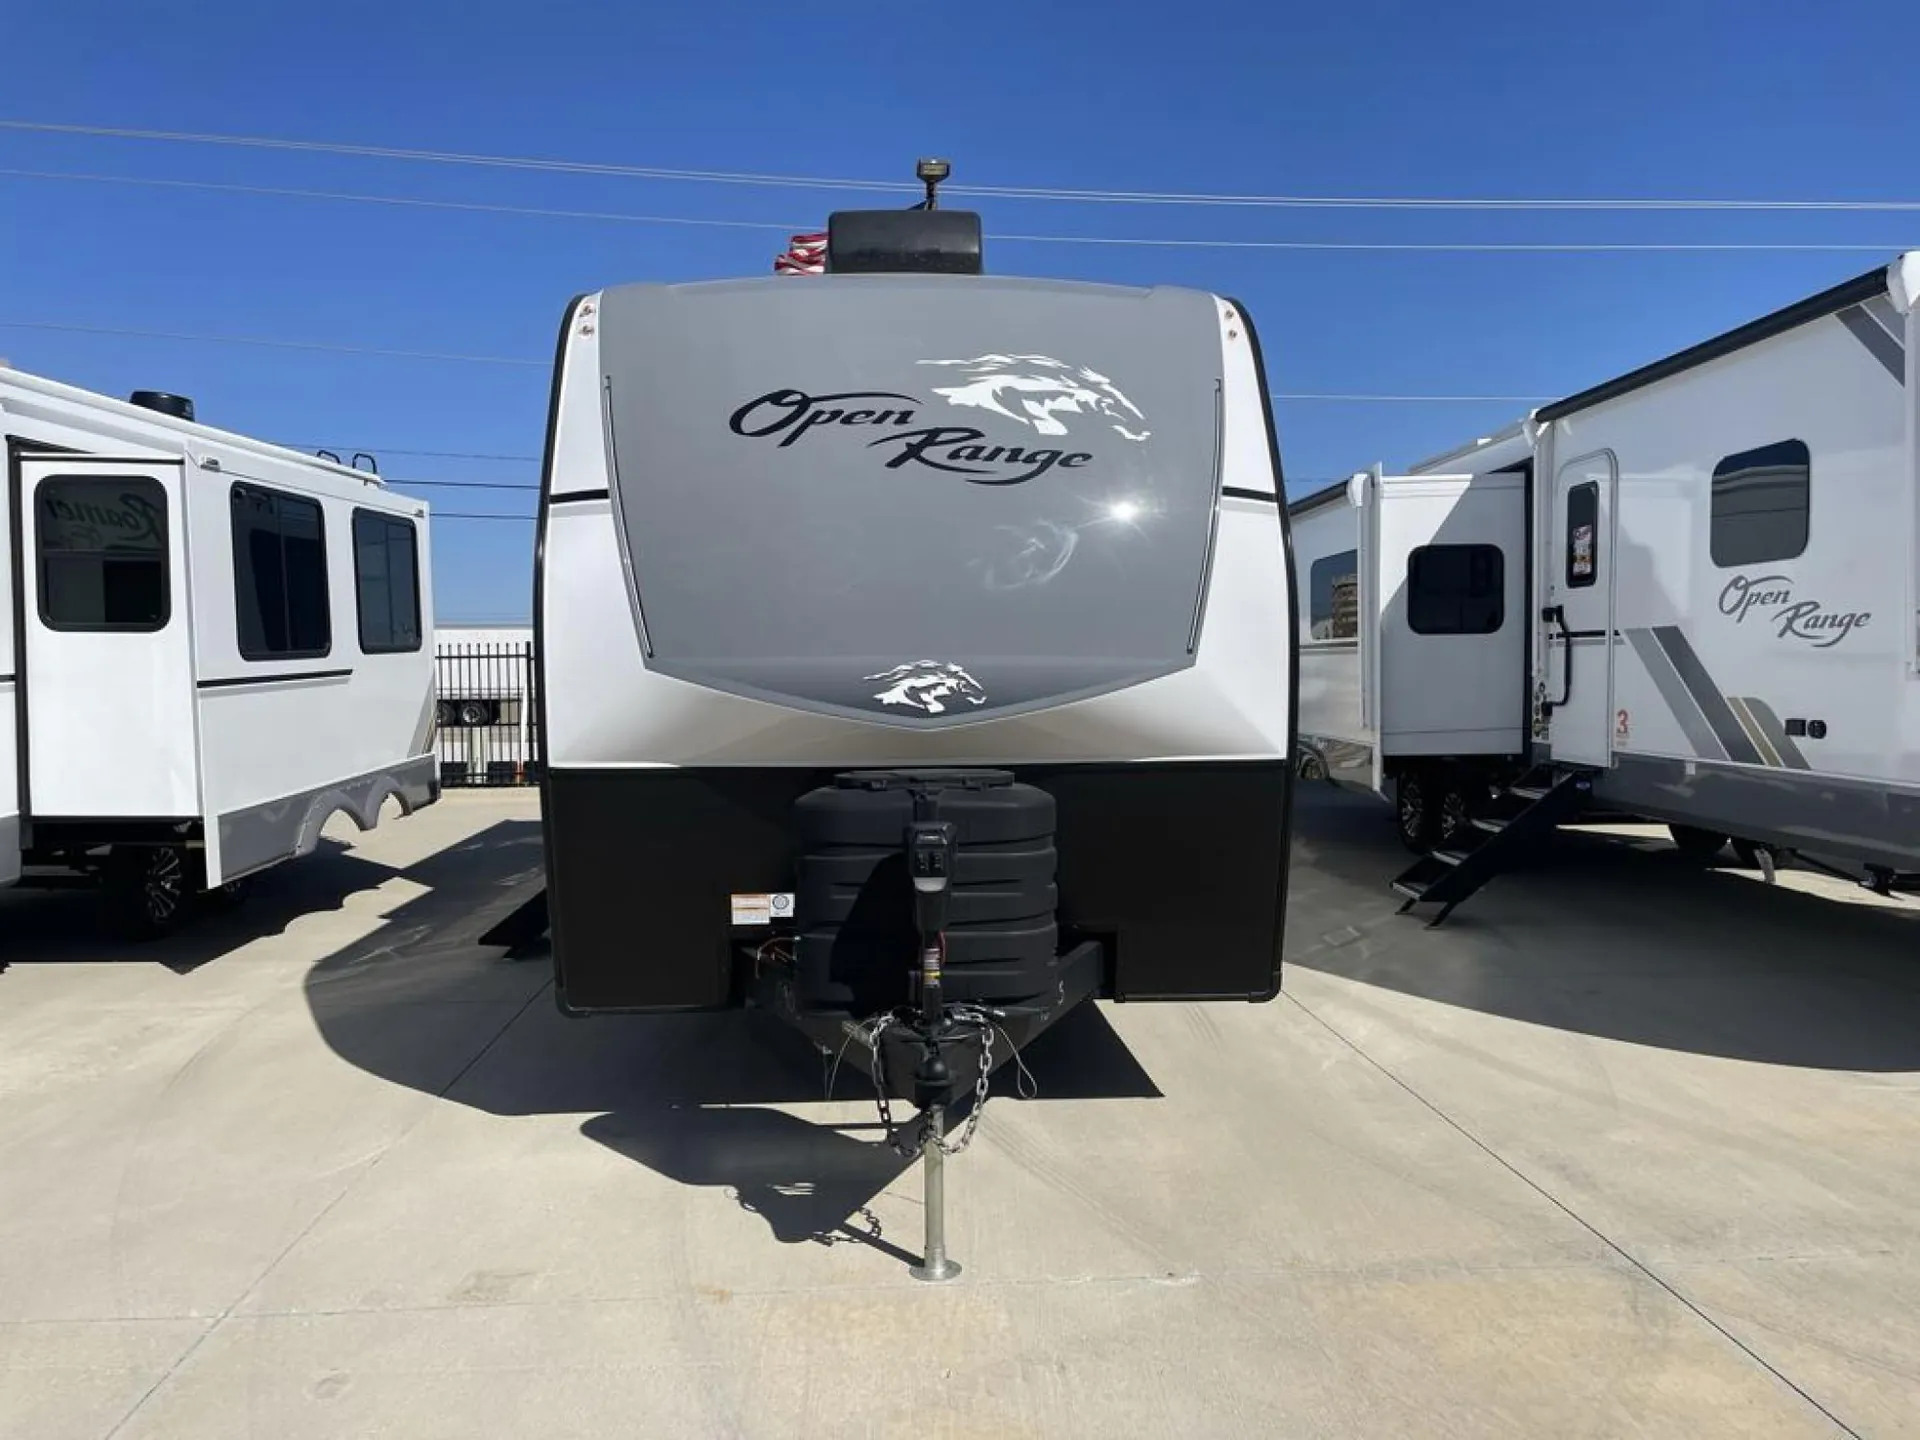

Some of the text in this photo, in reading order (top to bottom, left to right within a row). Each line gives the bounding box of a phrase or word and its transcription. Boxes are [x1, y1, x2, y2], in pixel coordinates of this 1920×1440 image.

[728, 389, 924, 447] Open
[867, 427, 1093, 485] Range
[1718, 575, 1794, 624] Open
[1770, 601, 1872, 647] Range
